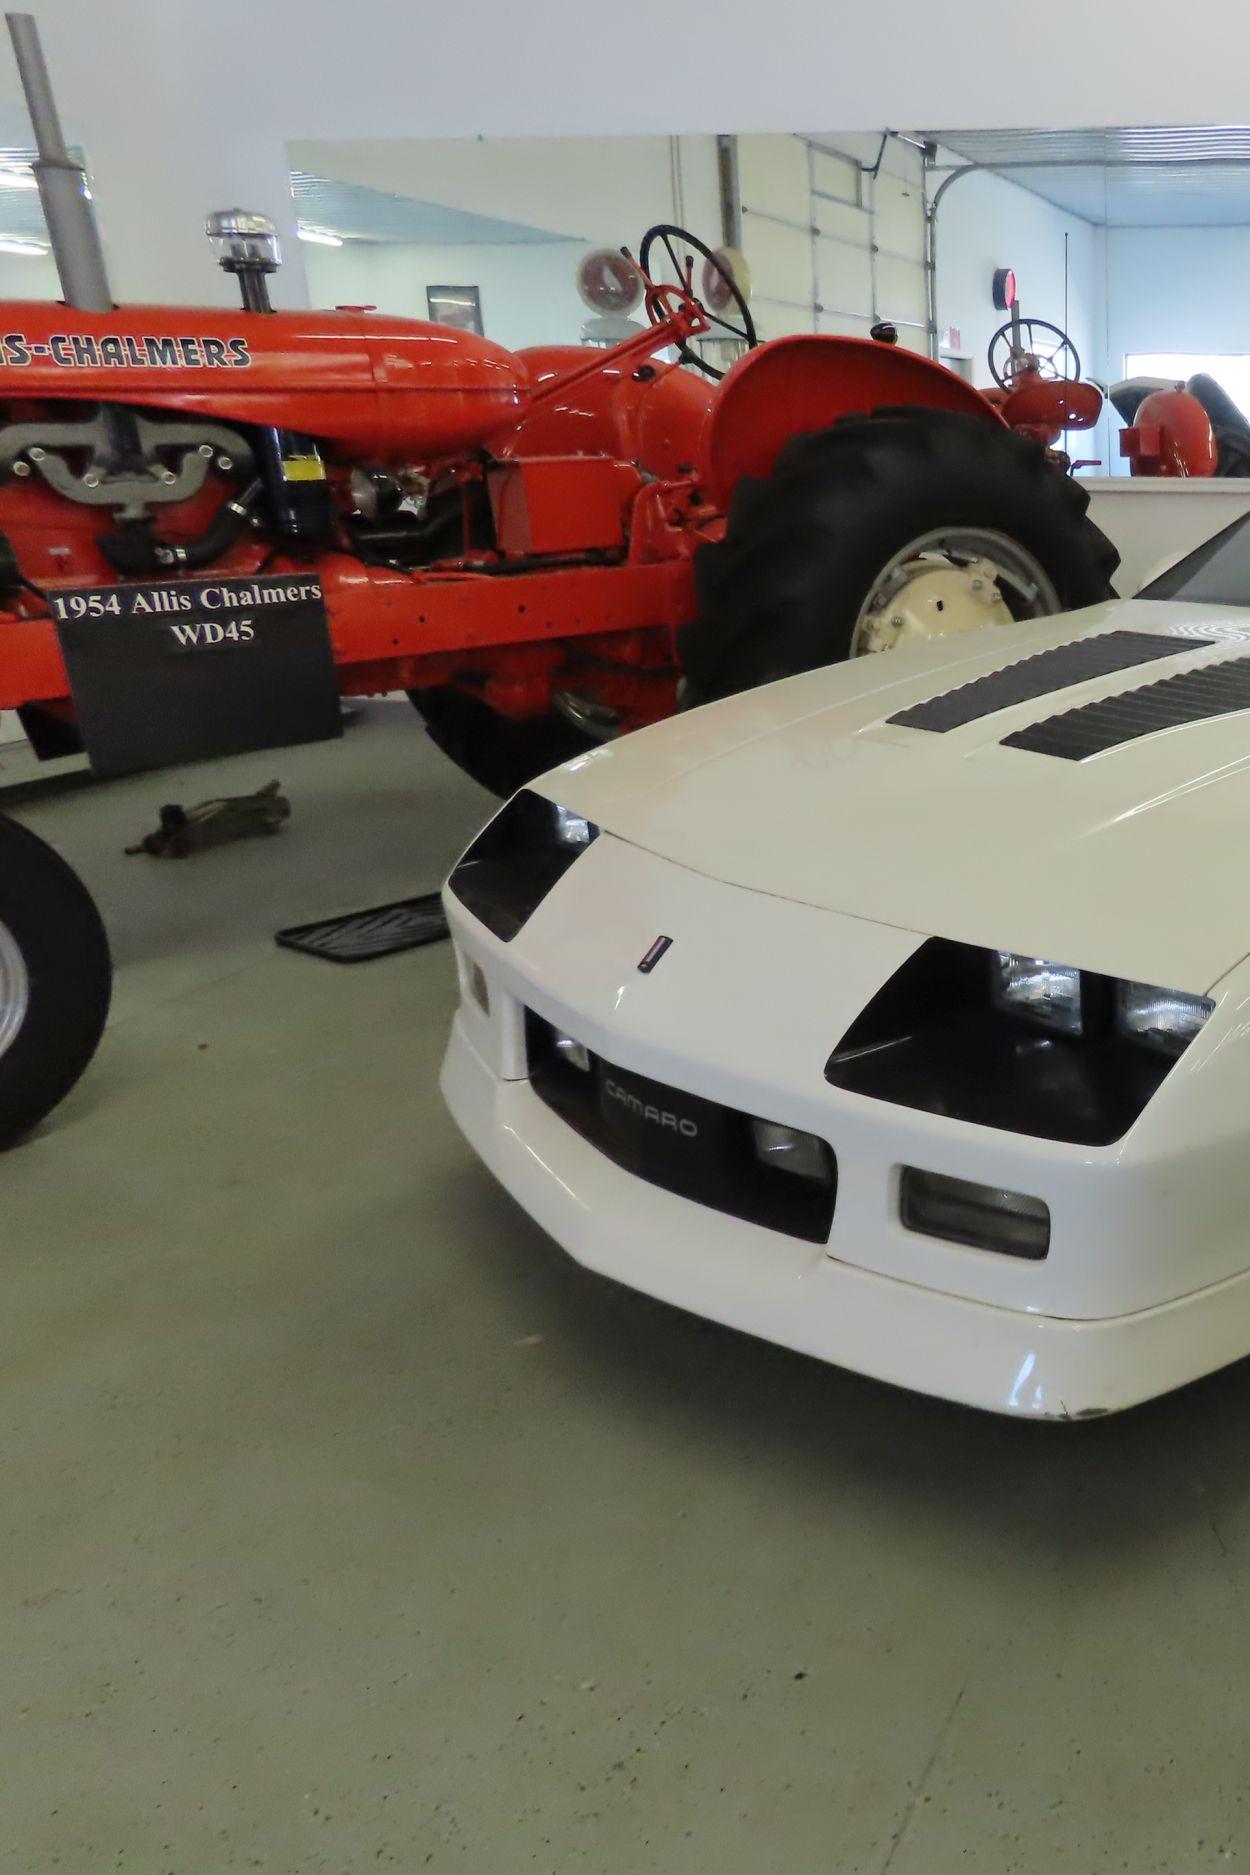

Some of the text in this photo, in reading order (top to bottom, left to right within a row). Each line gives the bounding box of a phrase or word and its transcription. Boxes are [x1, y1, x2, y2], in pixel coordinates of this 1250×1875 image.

[54, 584, 322, 619] 1954 Allis Chalmers
[170, 620, 255, 646] WD45
[605, 1079, 698, 1137] CAMARO
